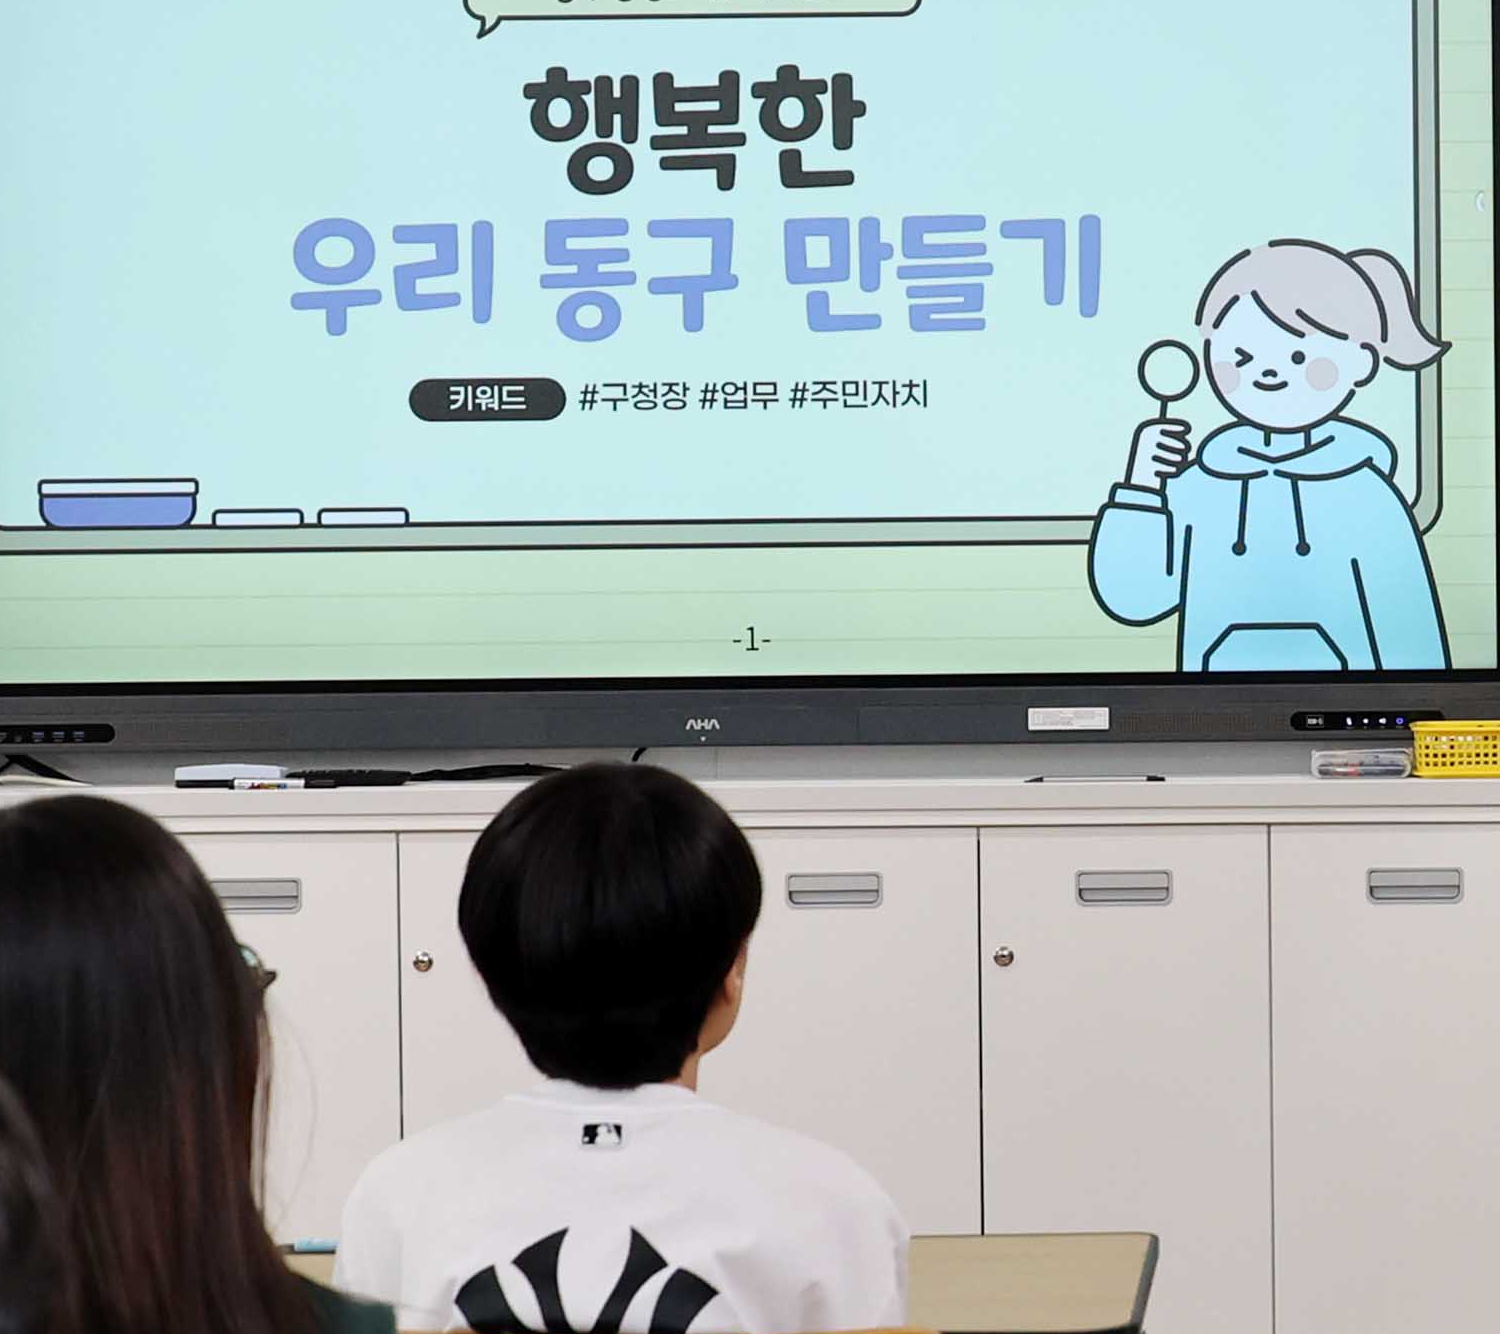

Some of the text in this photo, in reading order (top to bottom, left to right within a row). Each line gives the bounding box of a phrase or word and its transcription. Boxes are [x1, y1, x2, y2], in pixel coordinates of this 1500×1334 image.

[522, 63, 868, 196] 행복한
[290, 213, 1101, 343] 우리 동구 만들기
[449, 379, 929, 412] 키워드 #구청장 #업무 #주민자치
[685, 718, 721, 731] AHA
